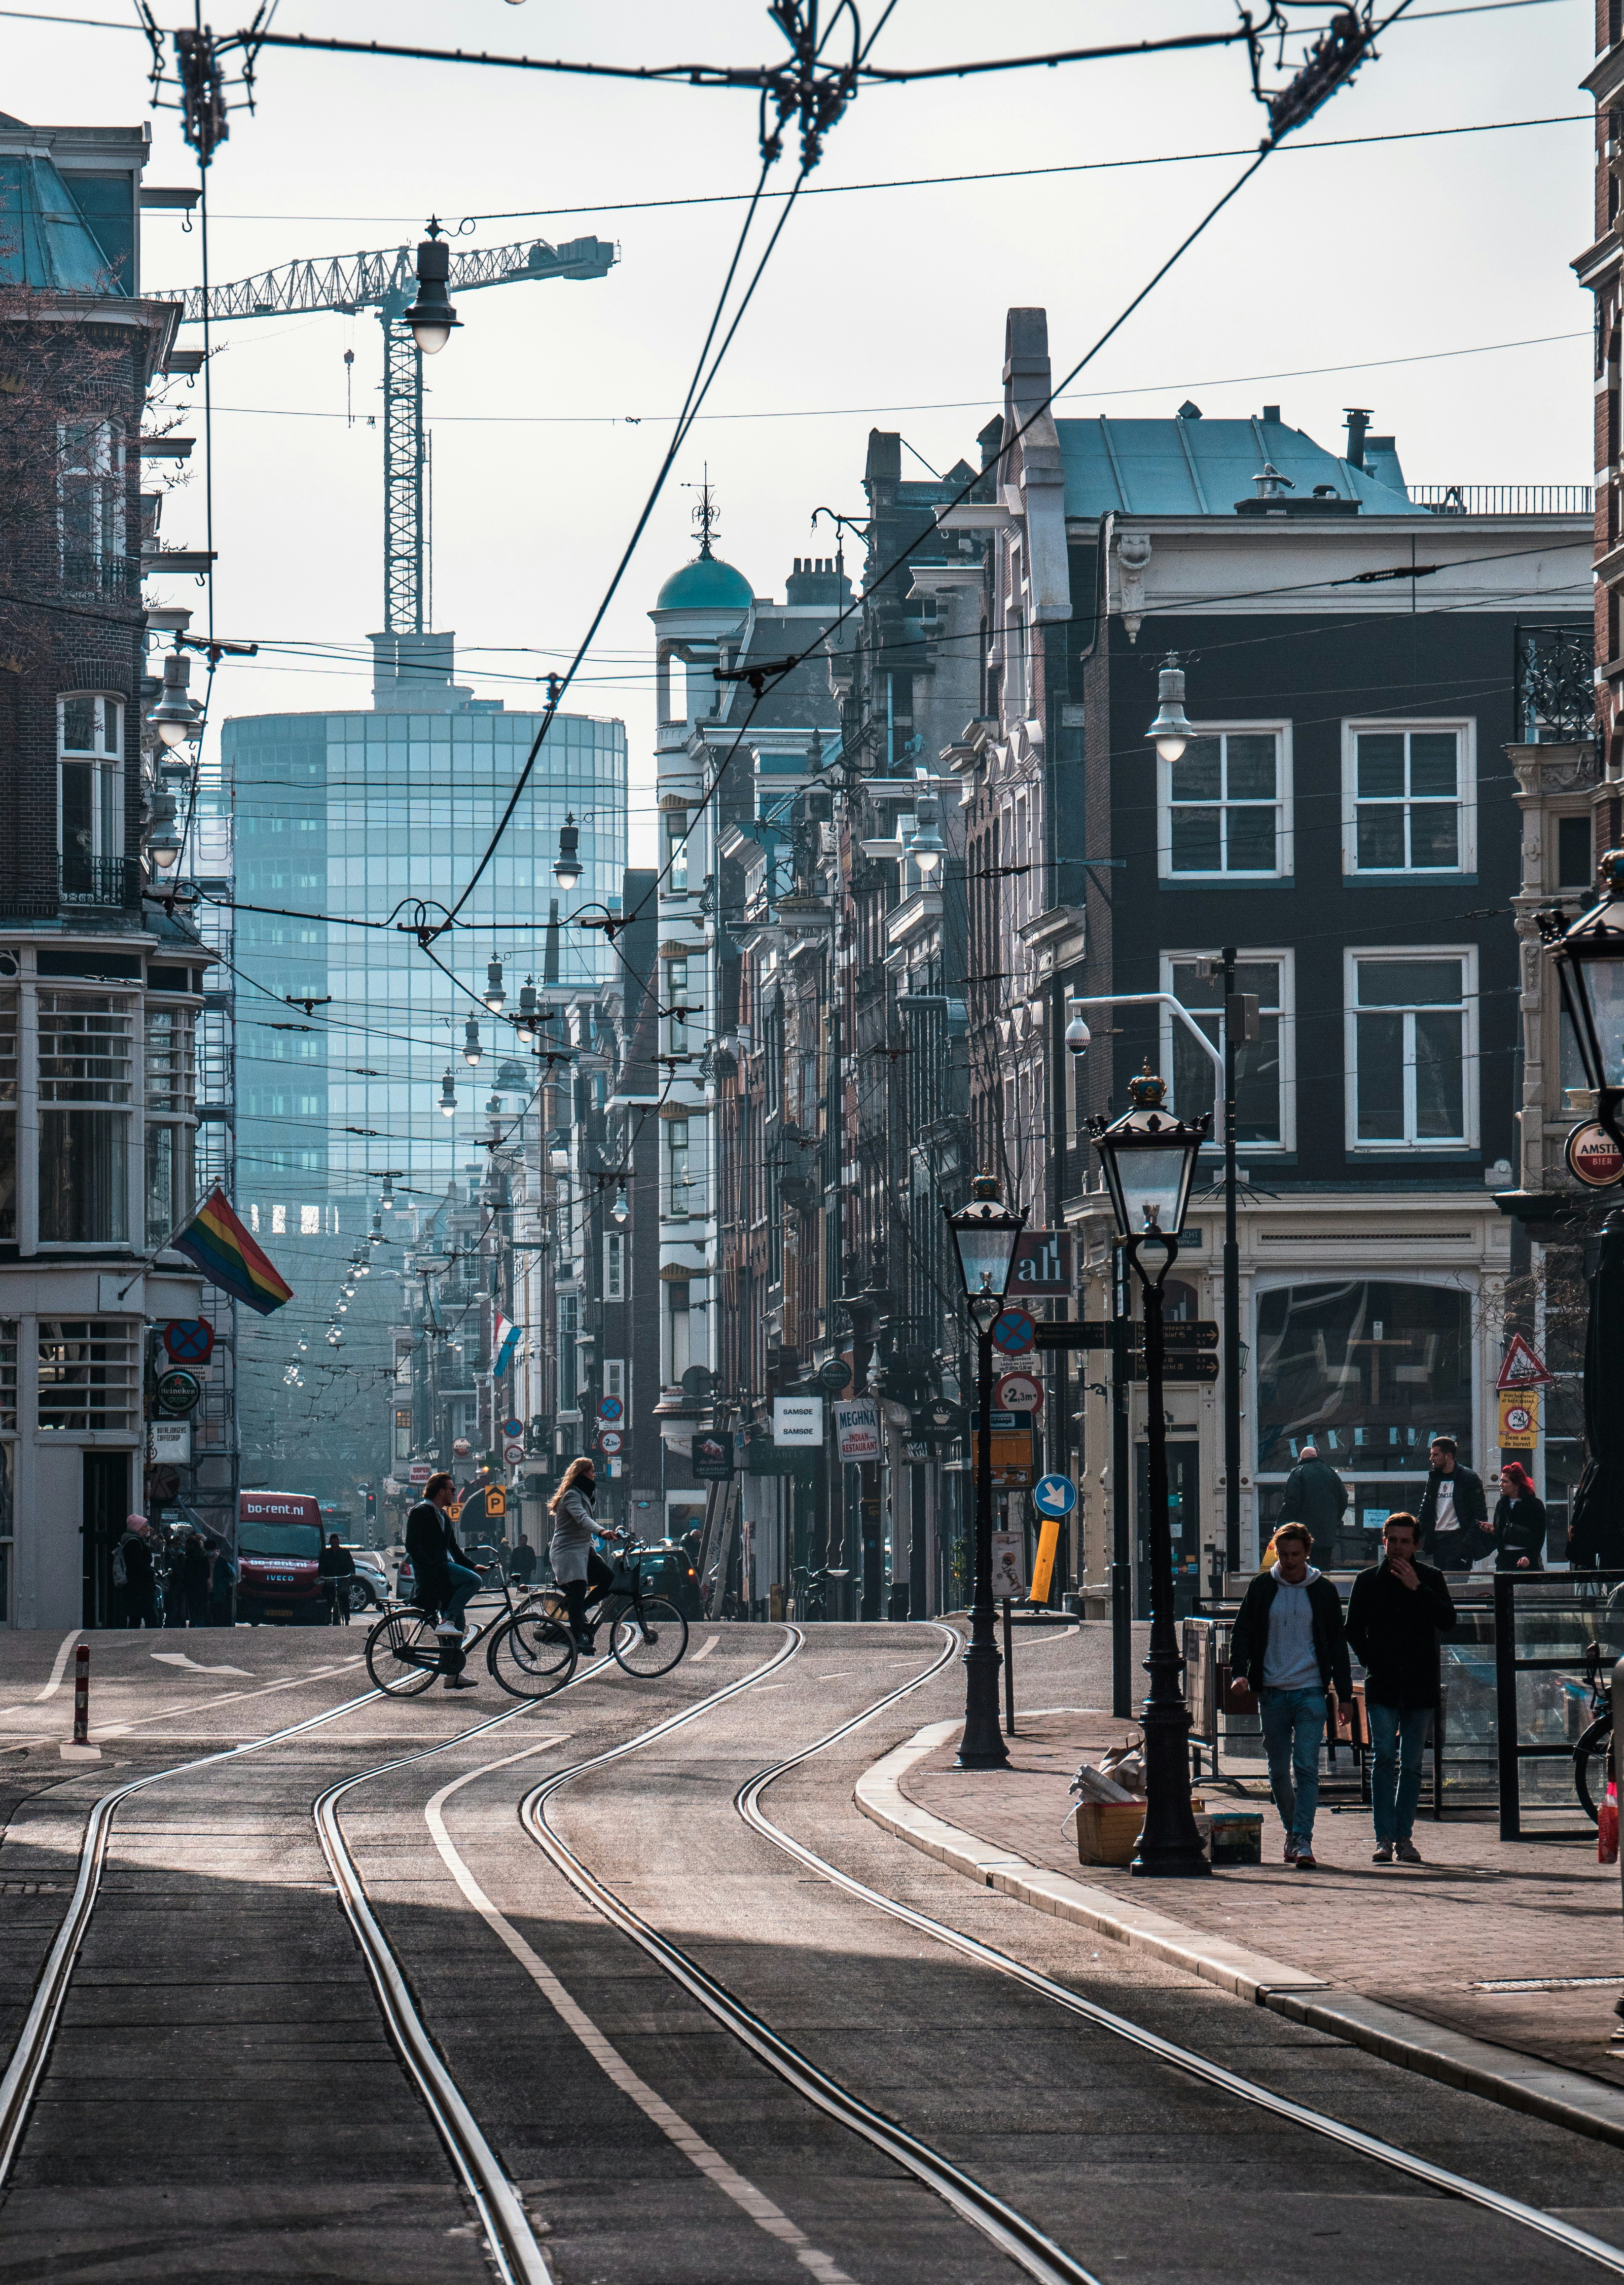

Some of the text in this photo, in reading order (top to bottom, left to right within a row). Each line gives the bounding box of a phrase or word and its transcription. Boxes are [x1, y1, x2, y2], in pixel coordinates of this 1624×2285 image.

[1581, 1144, 1620, 1154] AMSTE
[1018, 1232, 1064, 1281] ali
[1008, 1388, 1033, 1403] 2,3m
[840, 1410, 876, 1430] MEGHNA
[605, 1438, 618, 1447] 2,3m
[849, 1433, 869, 1443] INDIAN
[1285, 1427, 1369, 1458] TAKE
[842, 1441, 878, 1453] RESTAURANT
[491, 1498, 500, 1509] P
[247, 1504, 304, 1516] bo-rent.nl
[451, 1507, 458, 1517] P
[250, 1559, 308, 1568] bo-rent.nl
